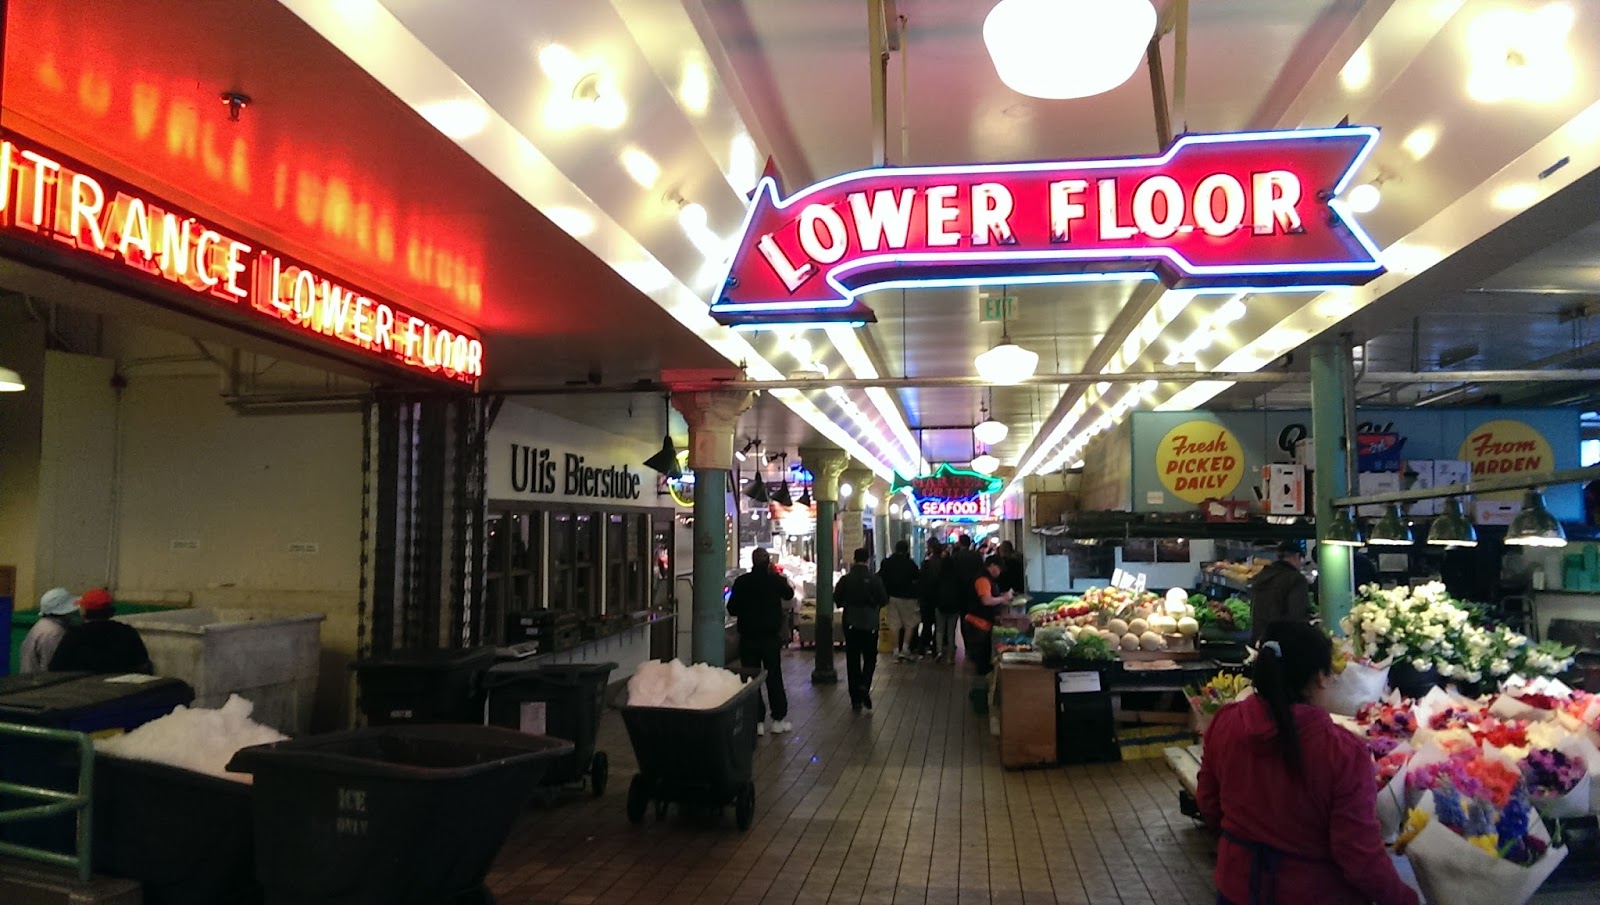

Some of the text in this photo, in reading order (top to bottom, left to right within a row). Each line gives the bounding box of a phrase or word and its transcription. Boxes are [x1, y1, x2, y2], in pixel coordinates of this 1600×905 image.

[757, 171, 1304, 294] LOWER FLOOR
[0, 141, 483, 377] TRANCE LOWER FLOOR
[1171, 430, 1228, 457] Fresh
[1471, 432, 1537, 457] From
[510, 443, 641, 500] Uli's Bierstube
[1165, 456, 1236, 475] PICKED
[1471, 456, 1542, 475] ARDEN
[1174, 474, 1229, 492] DAILY
[921, 501, 978, 515] SEAFOOD
